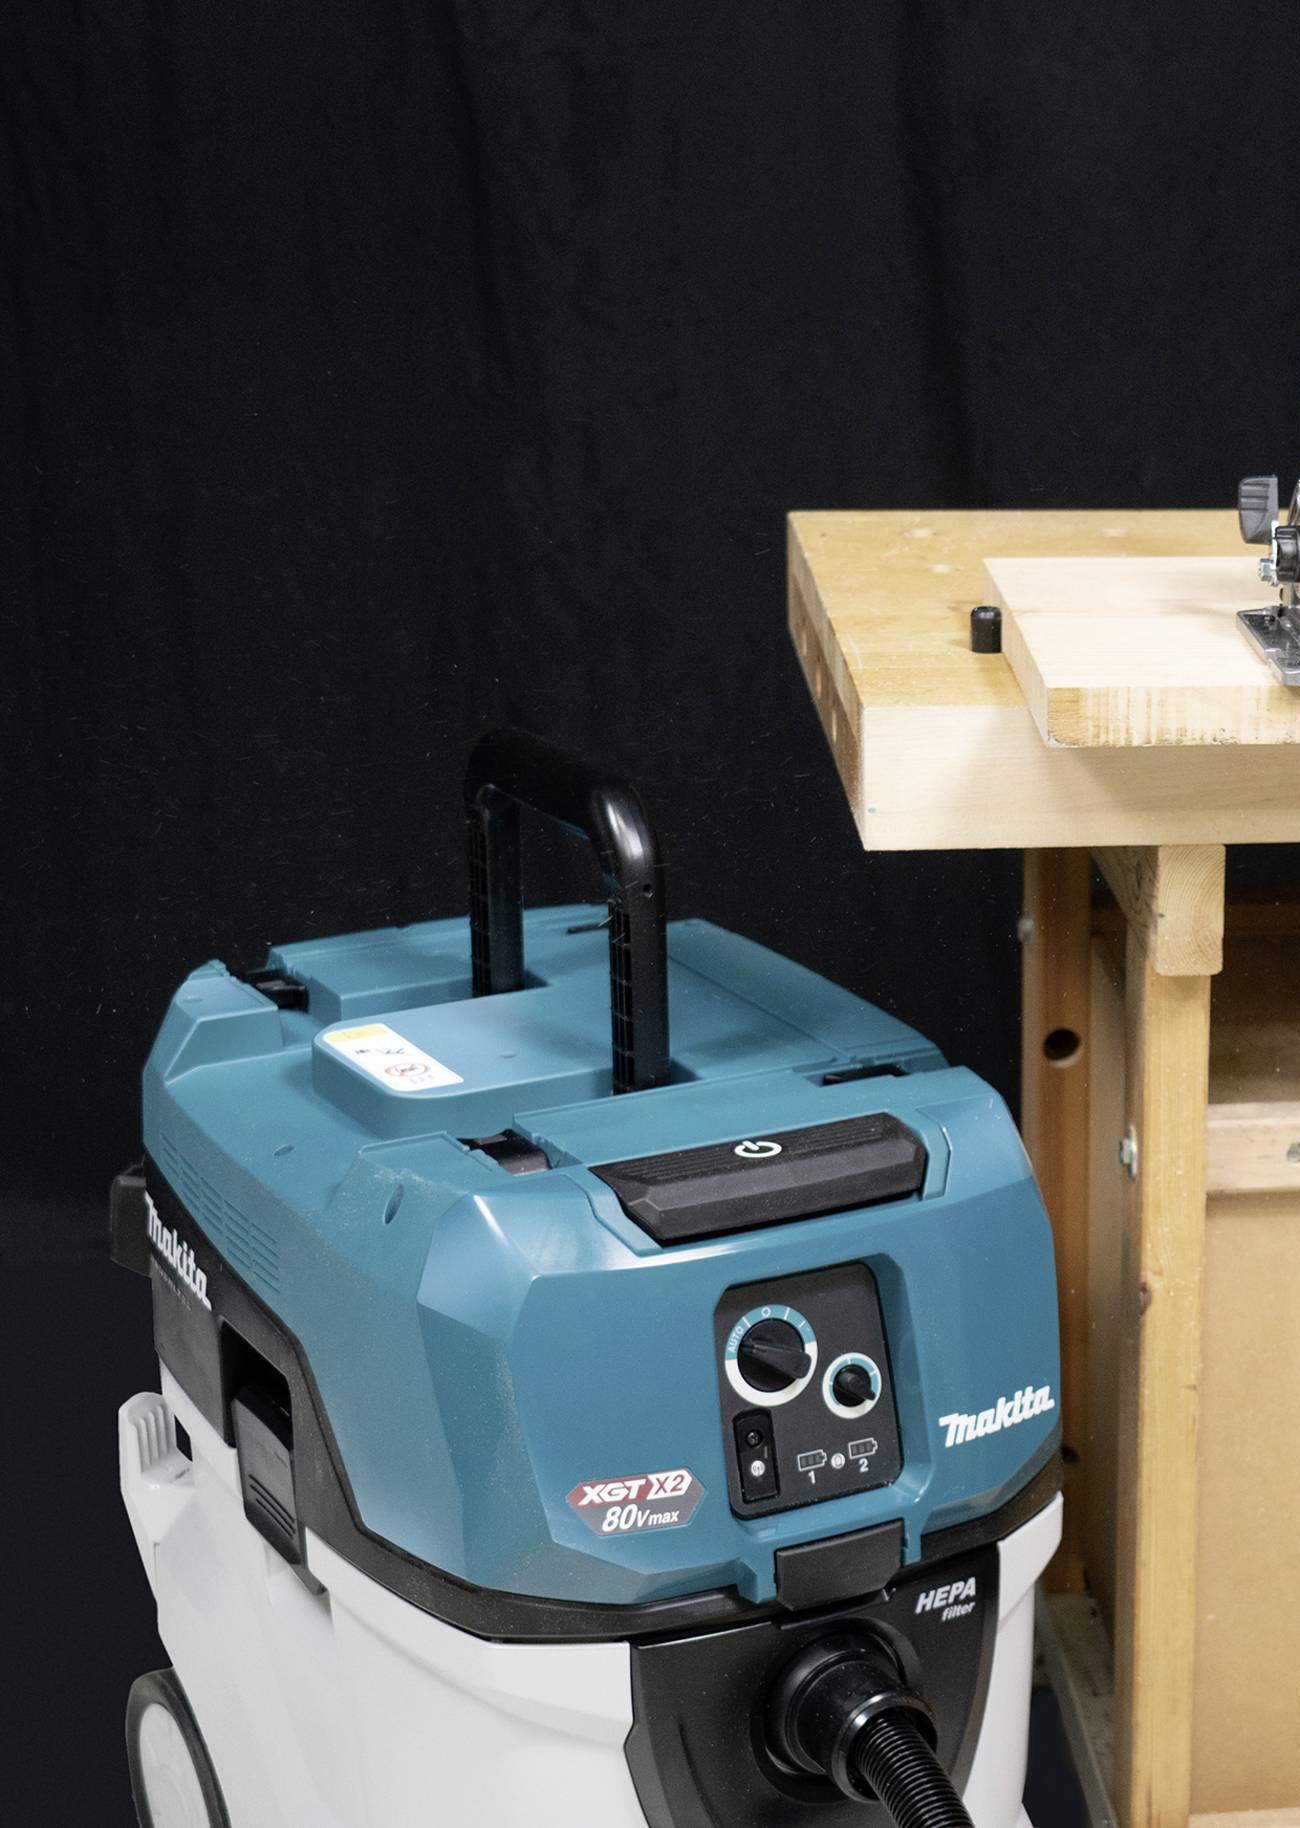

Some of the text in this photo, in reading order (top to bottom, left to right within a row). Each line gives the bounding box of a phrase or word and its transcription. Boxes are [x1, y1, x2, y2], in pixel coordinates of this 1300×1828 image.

[730, 1326, 744, 1353] AUTO
[938, 1385, 1055, 1448] Makita
[808, 1470, 816, 1484] 1
[859, 1458, 869, 1472] 2
[578, 1474, 685, 1506] XGT X2
[915, 1577, 976, 1614] HEPA
[941, 1601, 976, 1622] filter
